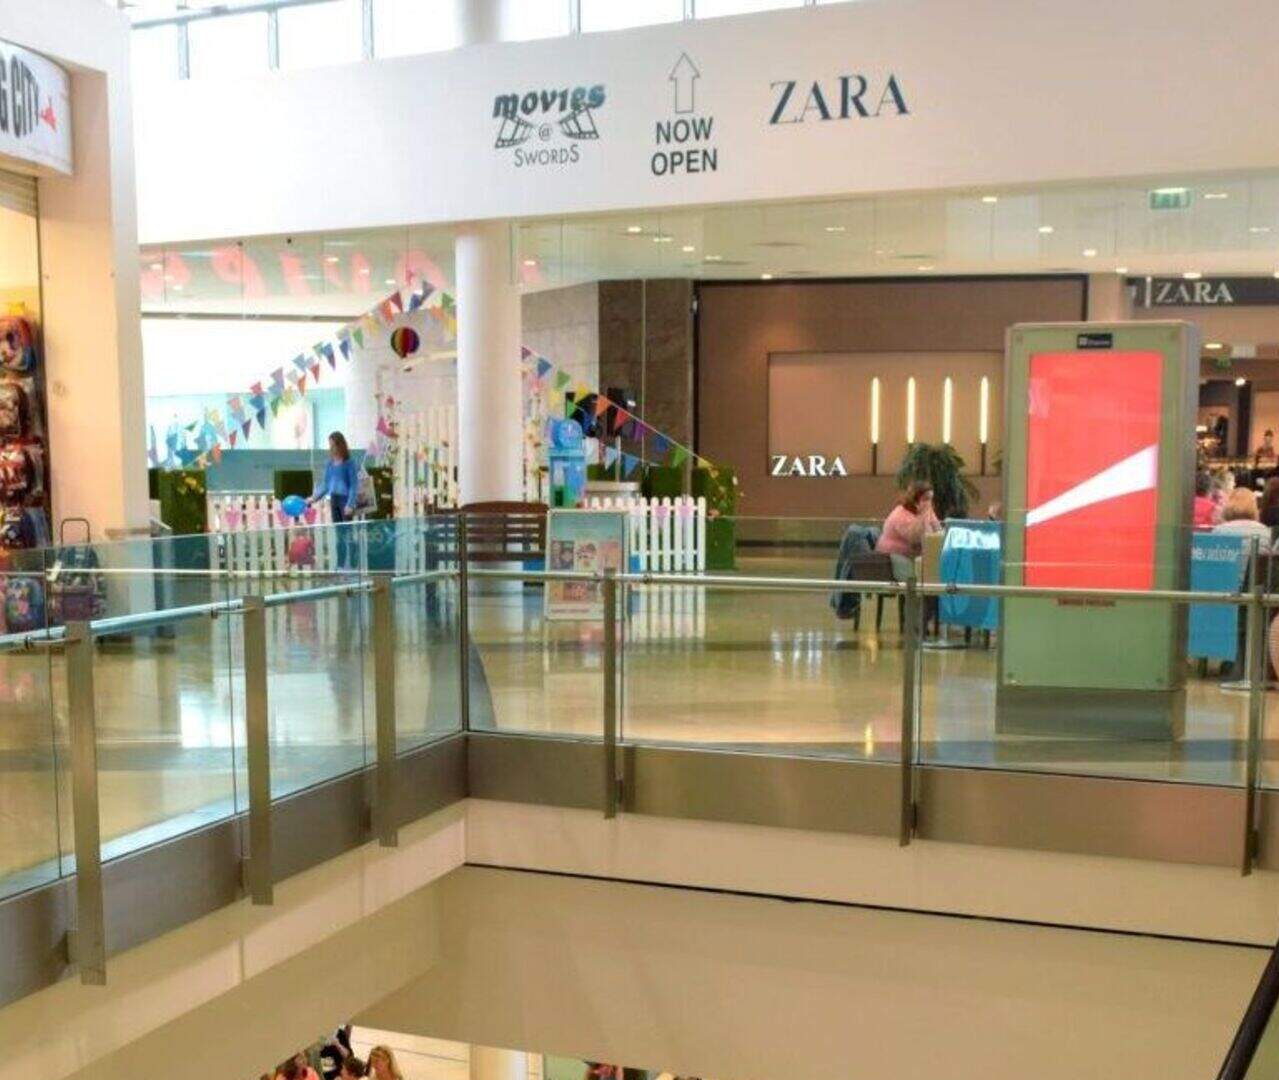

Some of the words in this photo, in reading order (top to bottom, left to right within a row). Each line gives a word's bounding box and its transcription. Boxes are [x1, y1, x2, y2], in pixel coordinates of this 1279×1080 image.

[10, 53, 40, 139] CITY
[493, 84, 606, 118] movies
[769, 73, 911, 125] ZARA
[539, 123, 553, 142] @
[655, 117, 714, 144] NOW
[651, 149, 718, 176] OPEN
[1155, 282, 1234, 304] ZARA
[771, 455, 848, 476] ZARA
